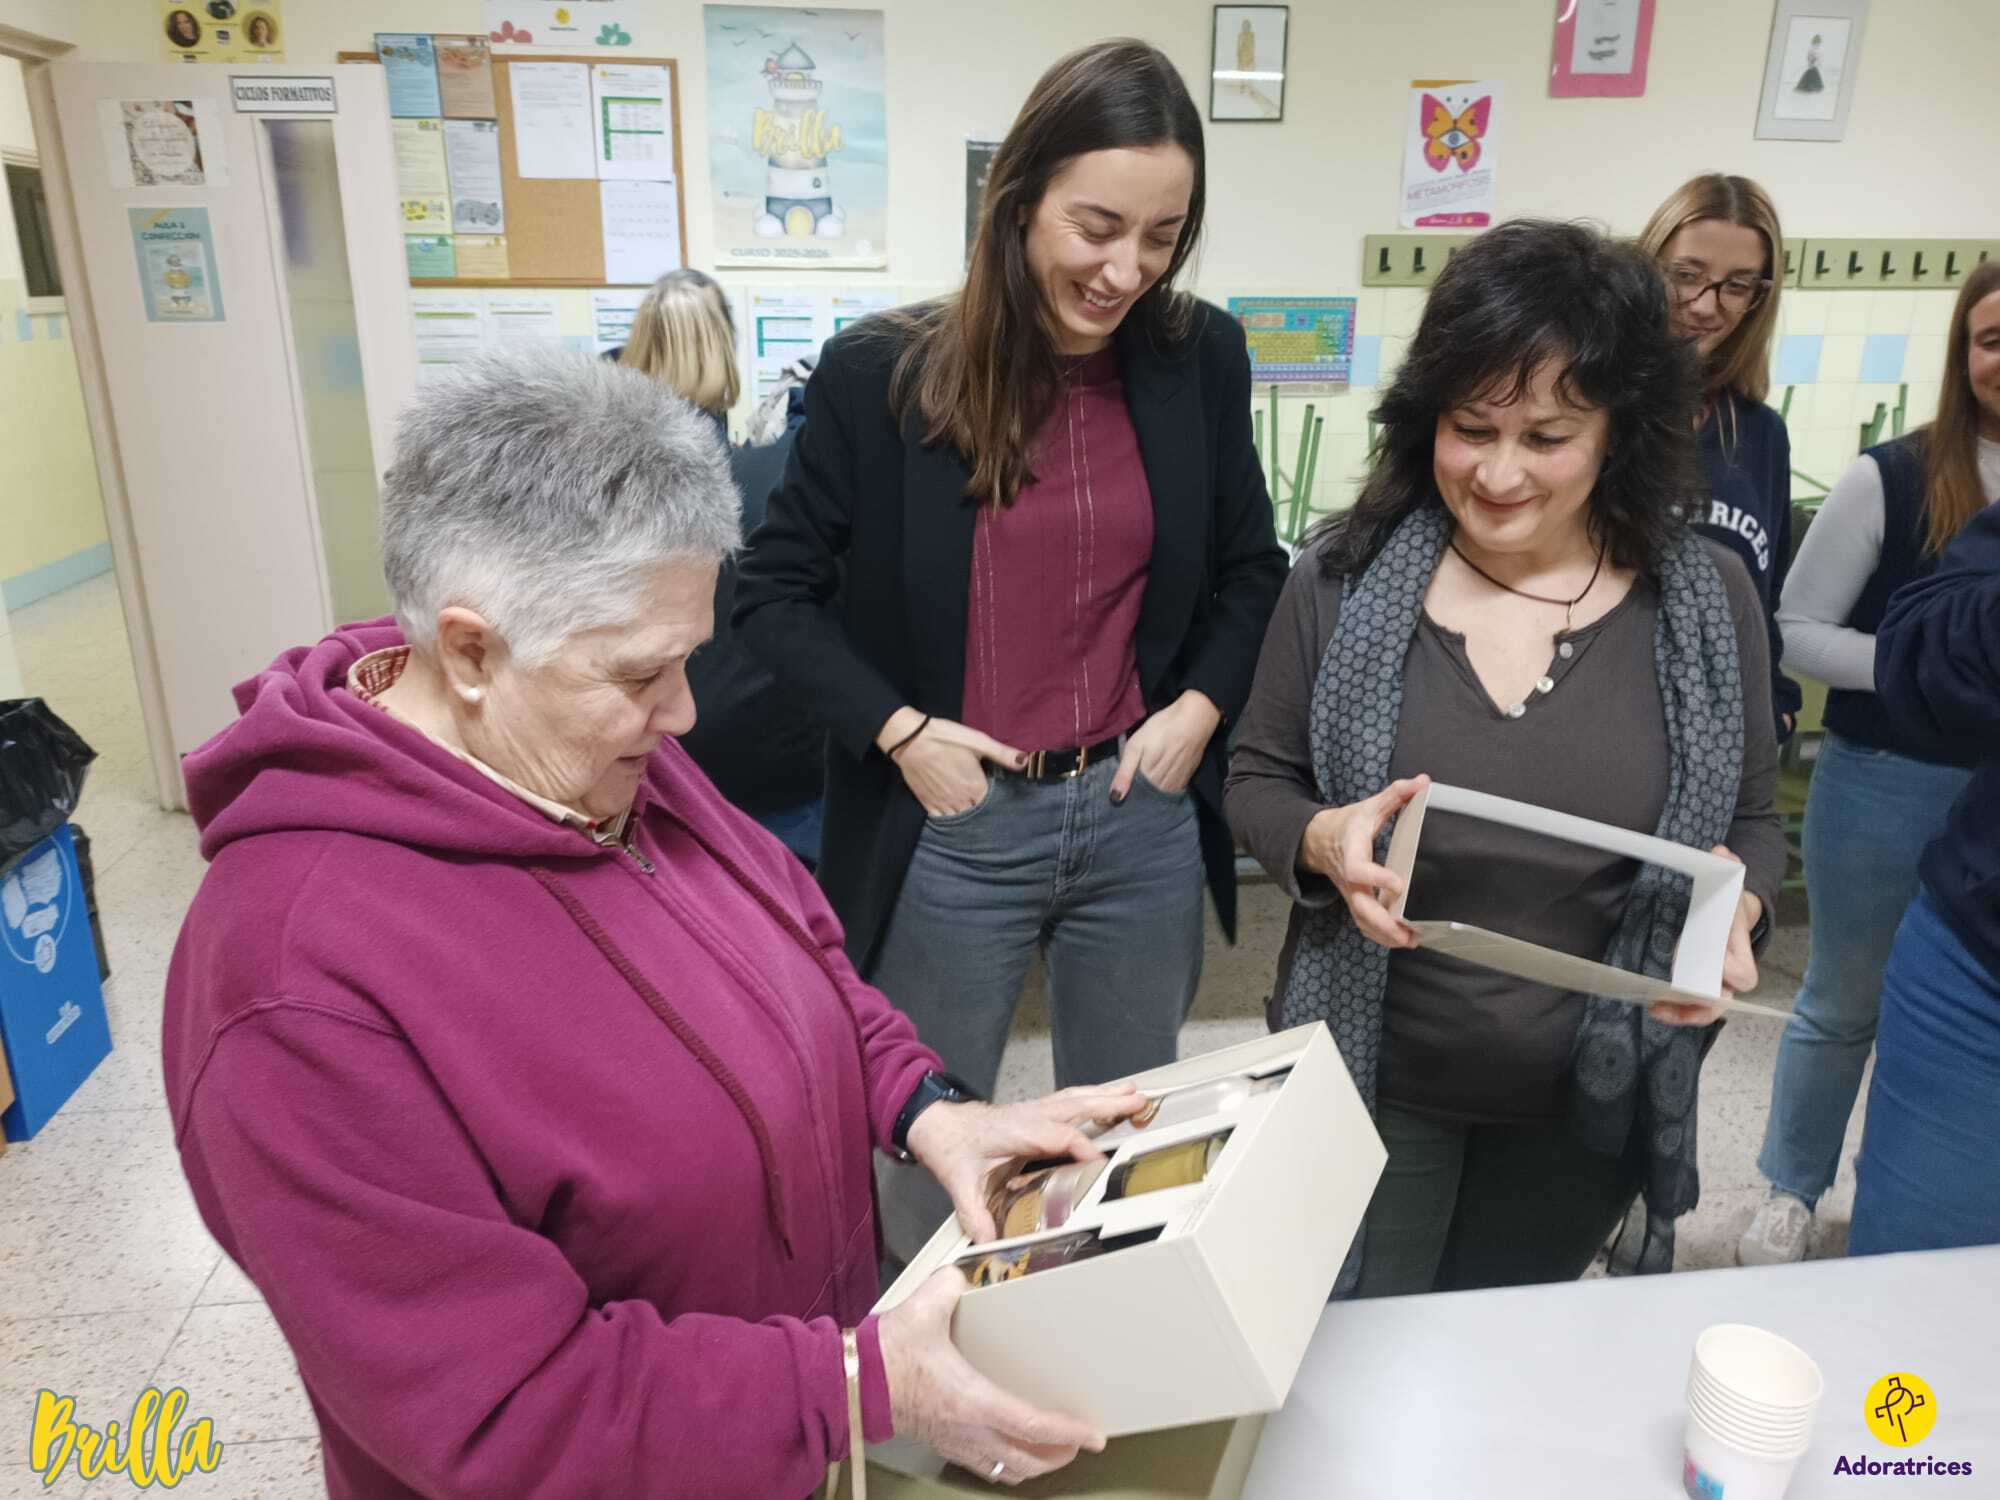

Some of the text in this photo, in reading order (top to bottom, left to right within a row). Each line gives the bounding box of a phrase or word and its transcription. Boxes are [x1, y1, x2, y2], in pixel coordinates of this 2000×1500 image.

[236, 86, 331, 102] CICLOS FORMATIVOS
[752, 107, 842, 159] Brilla
[730, 247, 770, 257] CURSO
[1708, 500, 1769, 571] RICES
